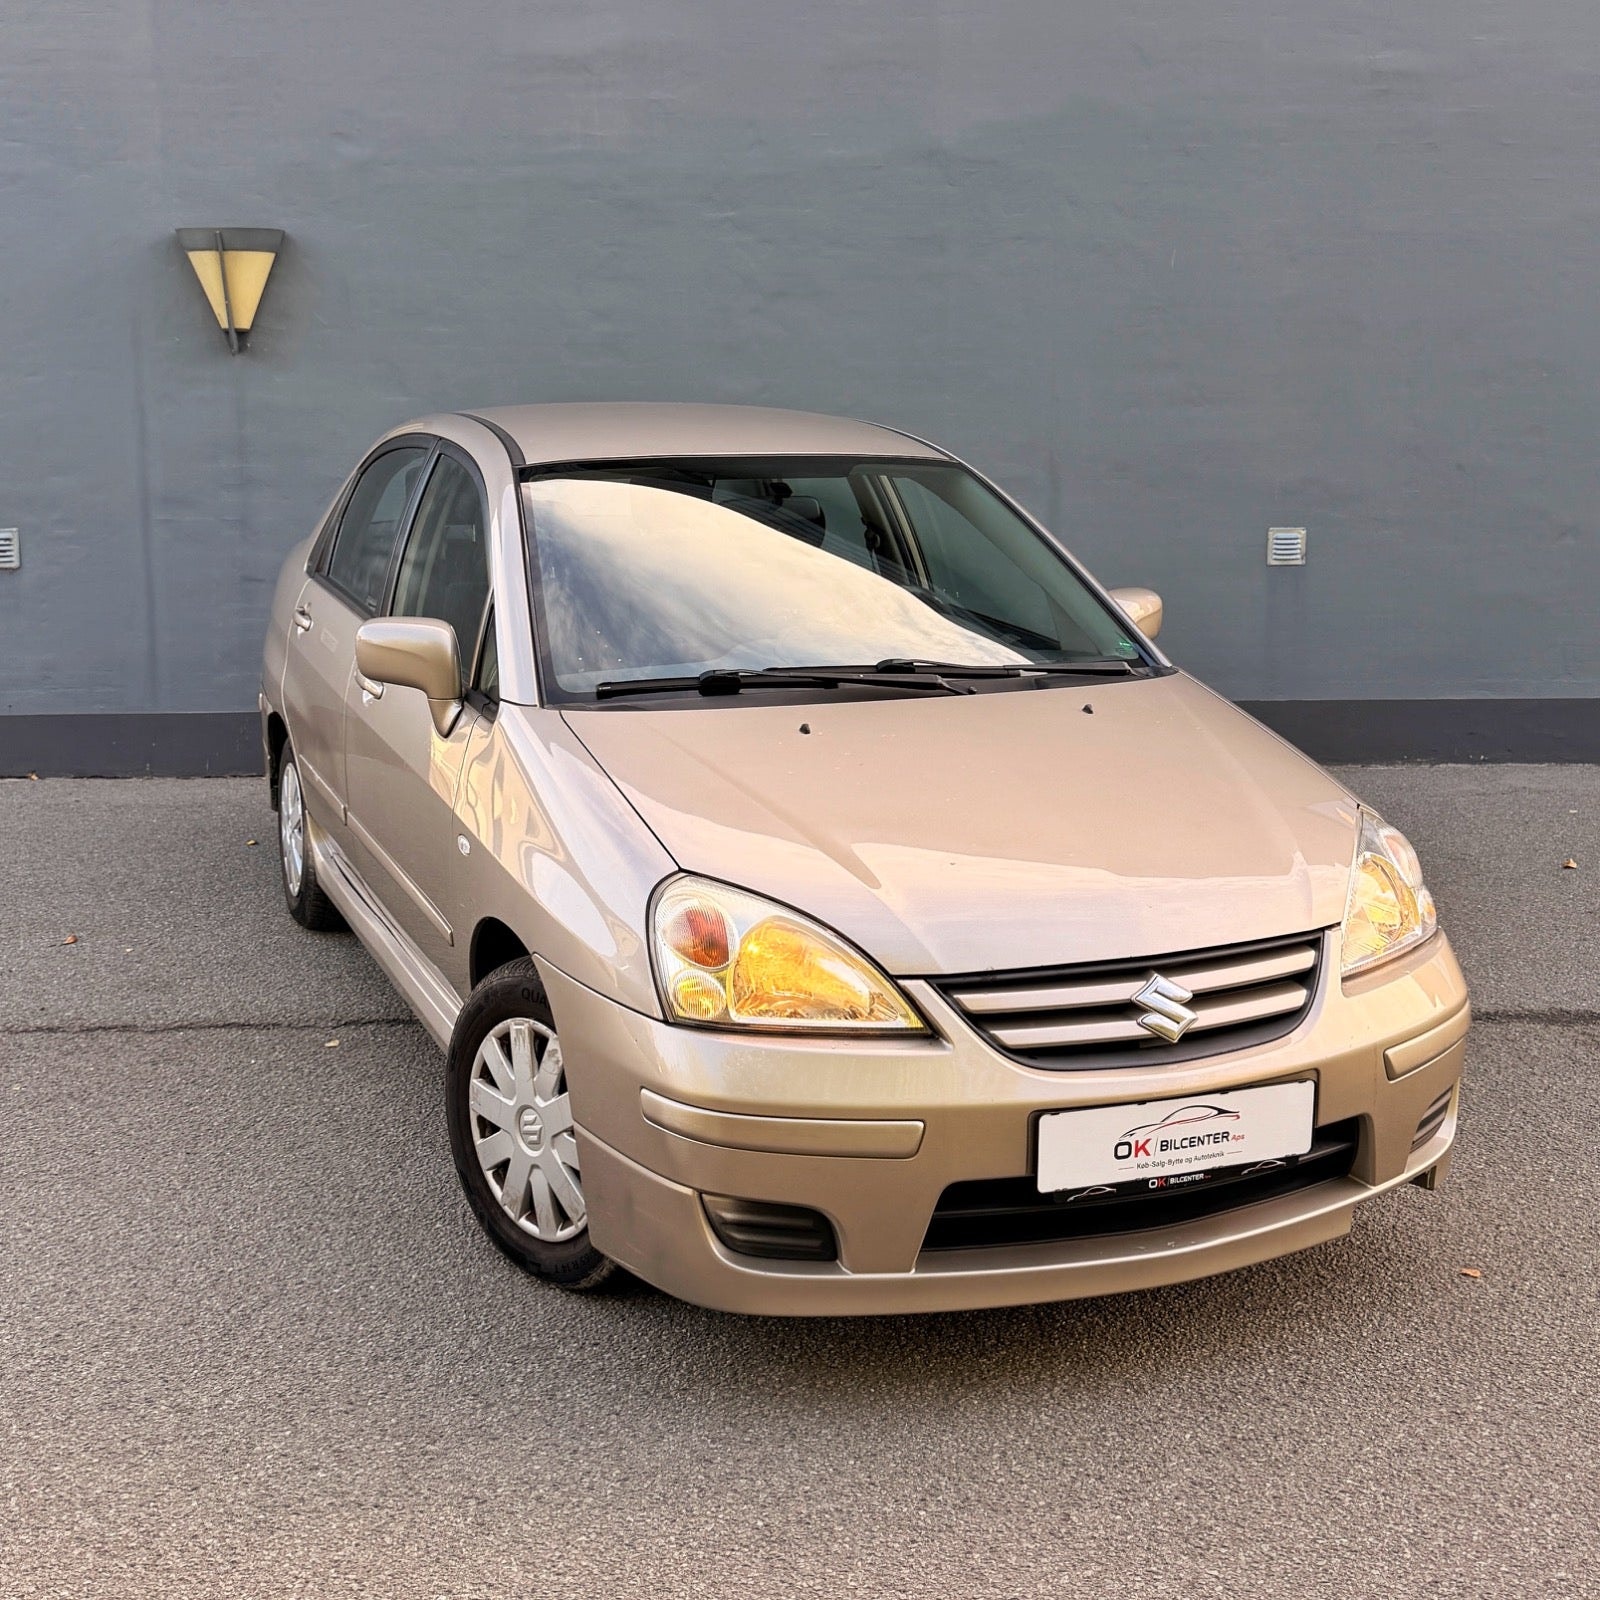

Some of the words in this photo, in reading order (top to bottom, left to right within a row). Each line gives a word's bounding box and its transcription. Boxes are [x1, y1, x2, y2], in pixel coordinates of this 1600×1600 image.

[1114, 1138, 1152, 1160] OK
[1159, 1131, 1230, 1152] BILCENTER
[1230, 1134, 1245, 1142] Aps
[1185, 1156, 1193, 1164] og
[1193, 1151, 1225, 1162] Autoteknik
[1148, 1177, 1166, 1189] OK
[1169, 1173, 1205, 1184] BILCENTER
